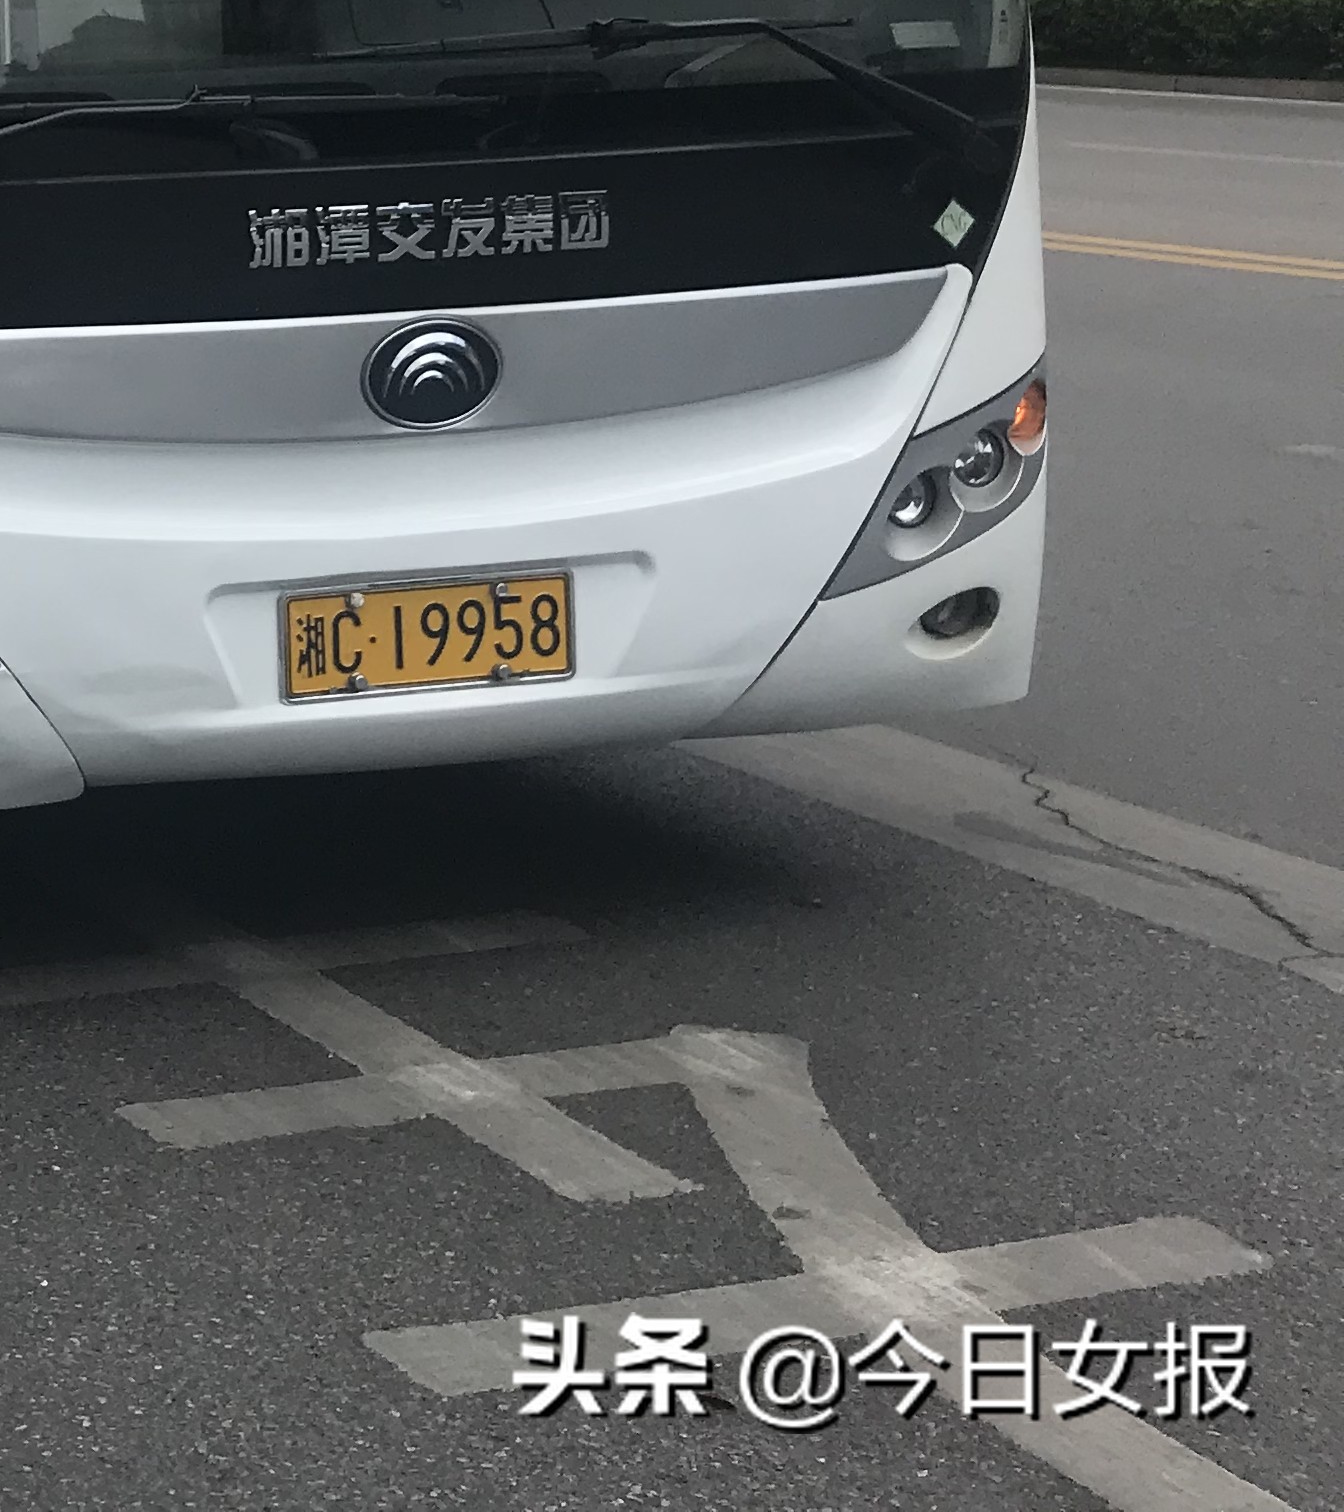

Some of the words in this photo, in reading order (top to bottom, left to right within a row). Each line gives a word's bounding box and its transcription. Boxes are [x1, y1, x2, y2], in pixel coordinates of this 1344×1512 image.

[248, 190, 610, 269] 湘潭交发集团
[296, 593, 561, 679] 湘C·19958
